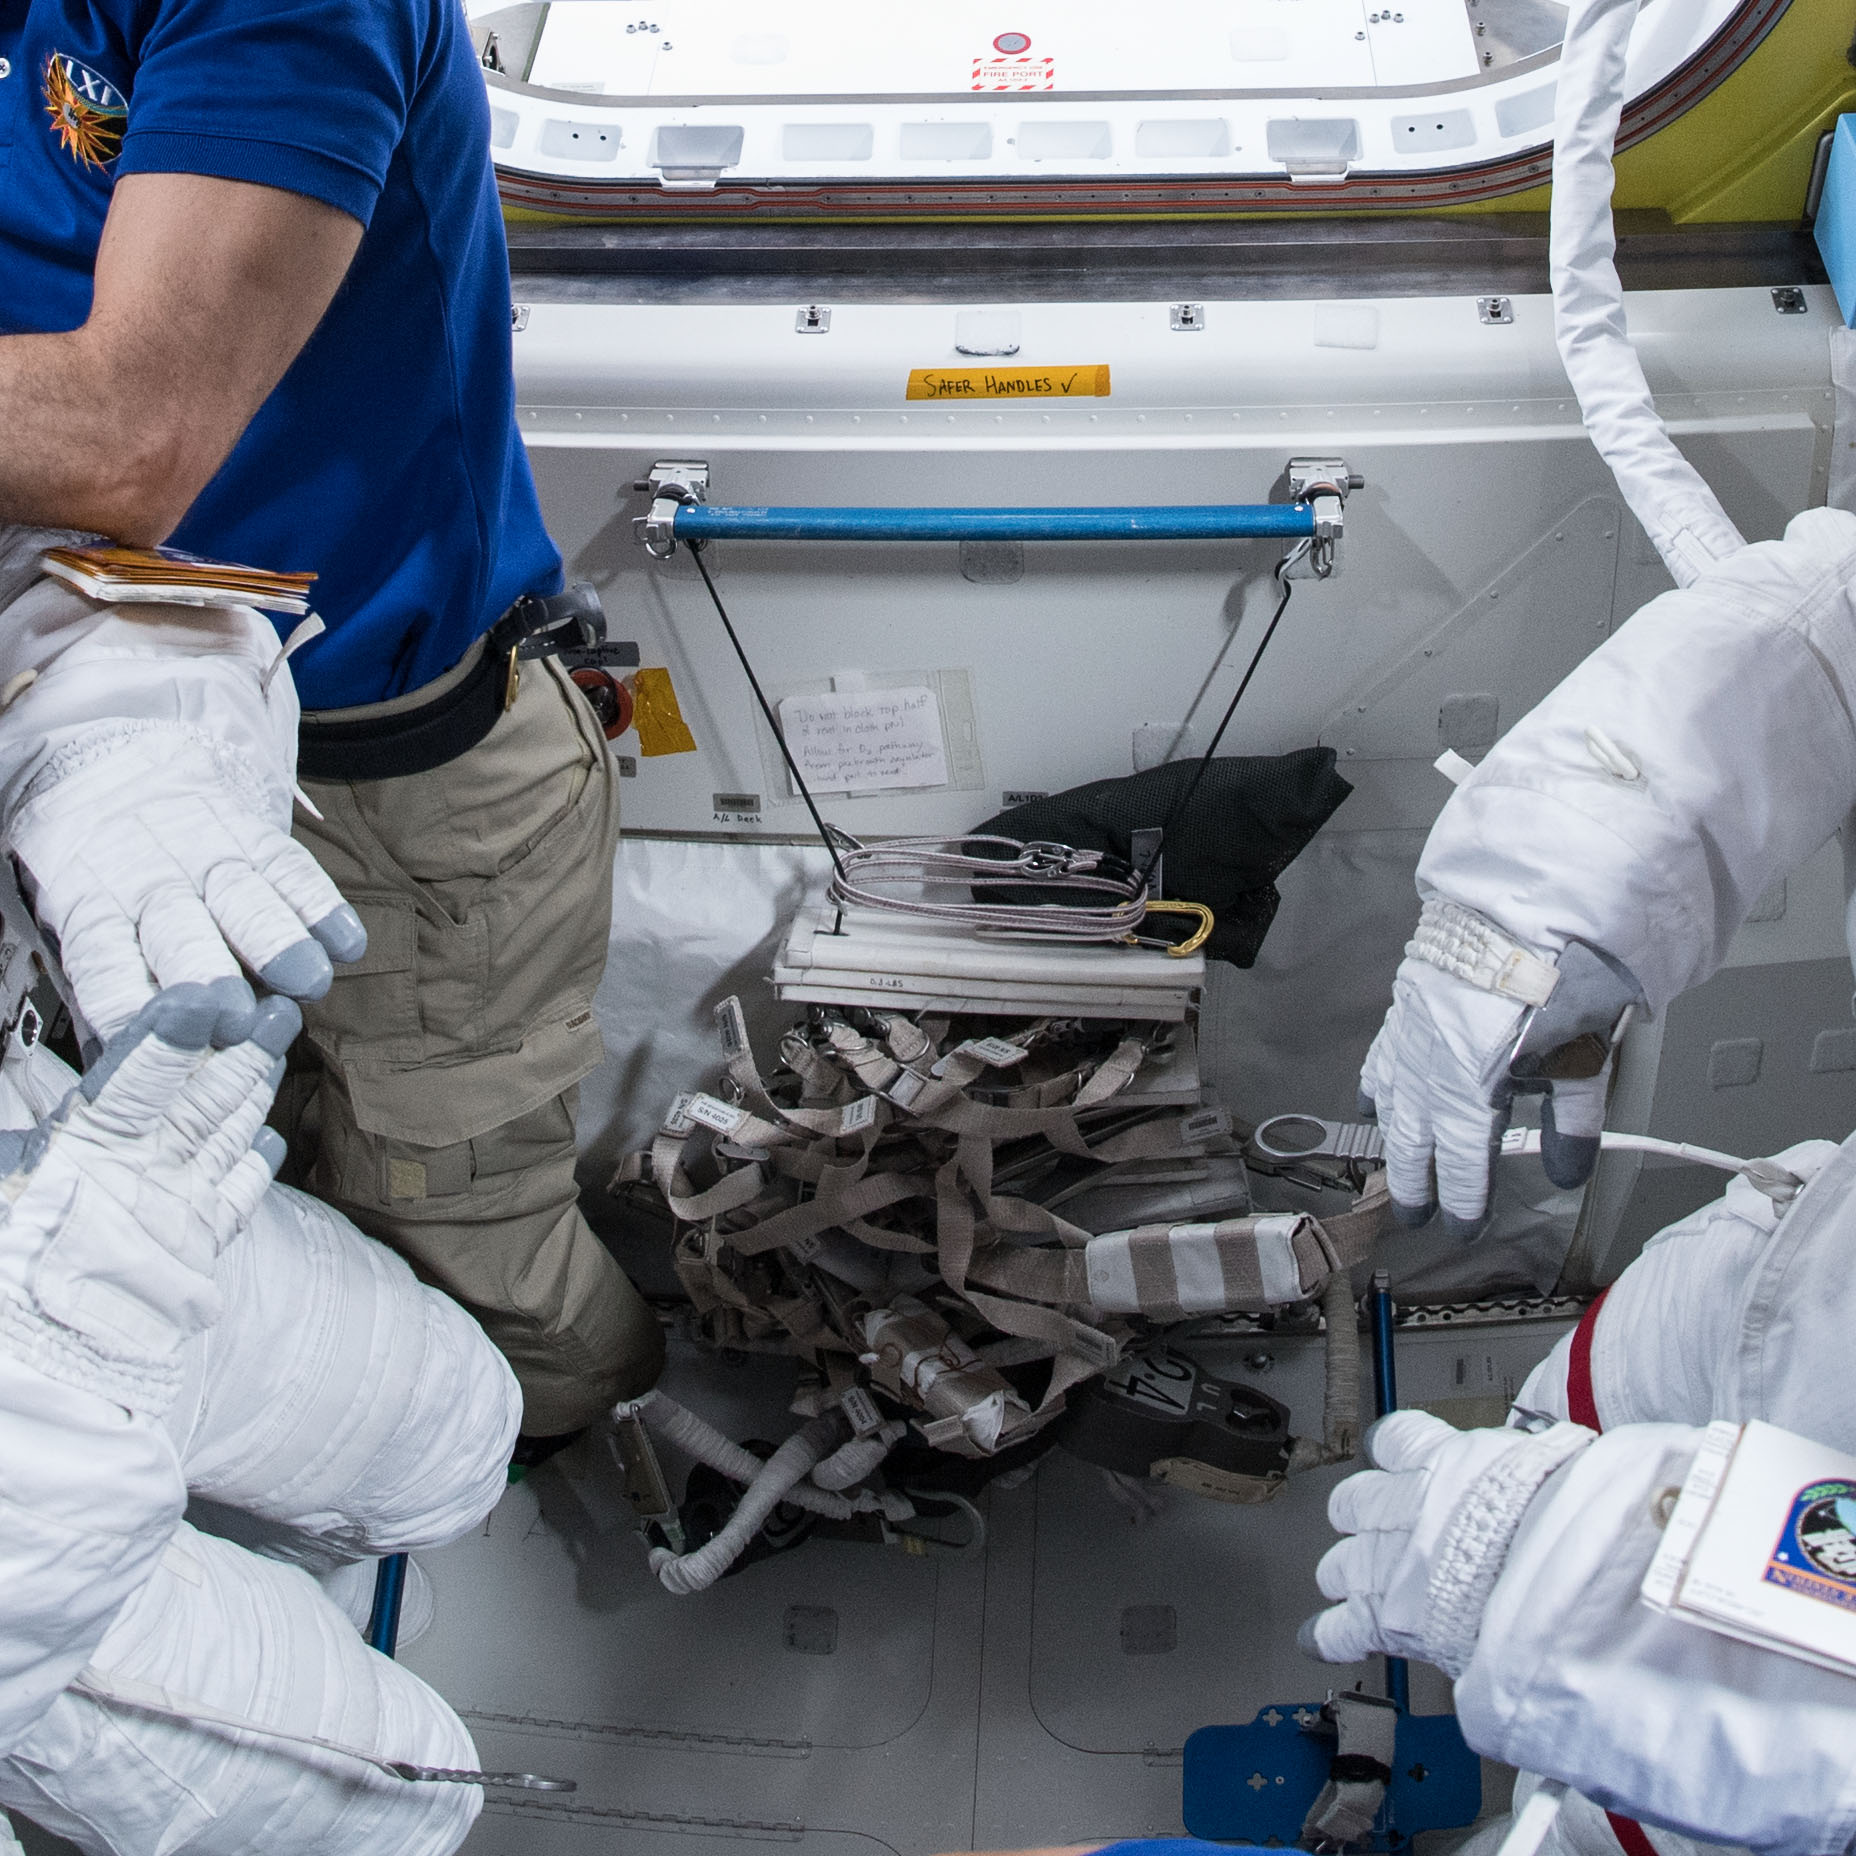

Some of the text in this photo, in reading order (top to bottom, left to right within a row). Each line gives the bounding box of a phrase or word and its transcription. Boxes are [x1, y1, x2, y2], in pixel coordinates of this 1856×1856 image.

[1012, 70, 1043, 78] PORT
[66, 59, 112, 106] LXI
[923, 373, 1053, 398] SAFER HANDLES
[713, 813, 731, 823] A/L
[695, 1106, 712, 1119] S/N
